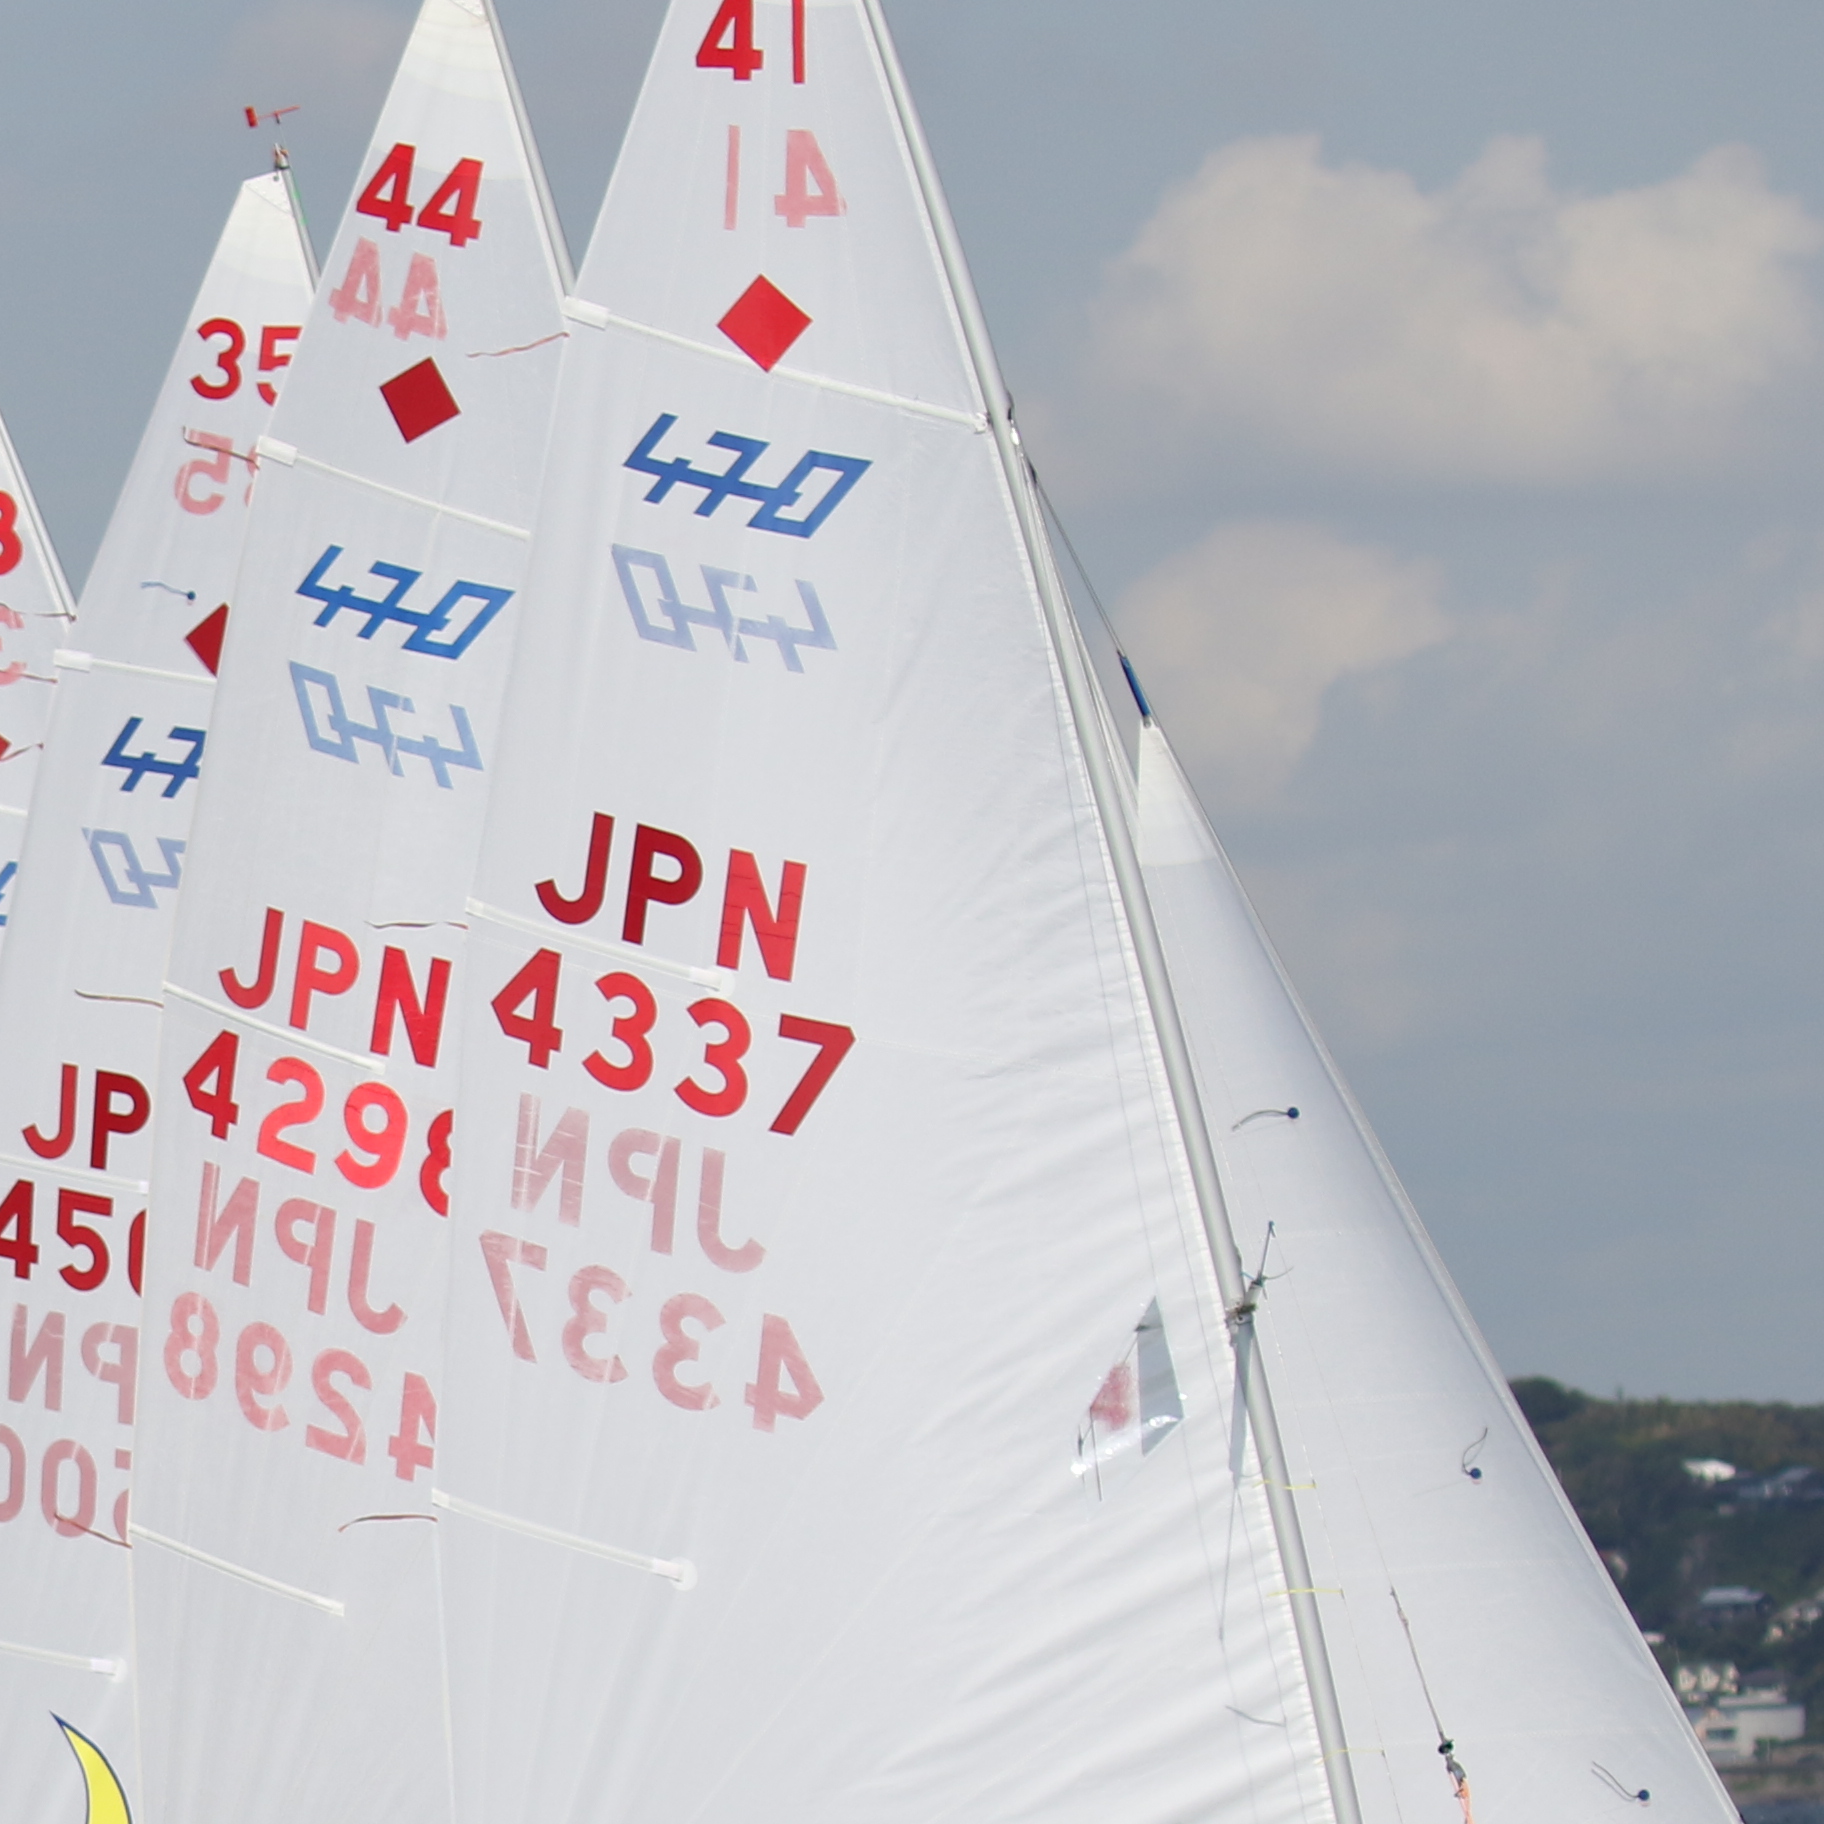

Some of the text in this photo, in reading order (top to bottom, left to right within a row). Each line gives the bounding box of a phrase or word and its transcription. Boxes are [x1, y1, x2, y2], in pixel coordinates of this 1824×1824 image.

[694, 0, 805, 83] 41
[357, 143, 485, 248] 44
[189, 317, 301, 407] 35
[622, 412, 874, 539] 470
[296, 545, 516, 661] 470
[534, 811, 807, 983] JPN
[218, 907, 452, 1068] JPN
[490, 947, 857, 1137] 4337
[22, 1062, 152, 1170] JP
[182, 1029, 454, 1219] 4298
